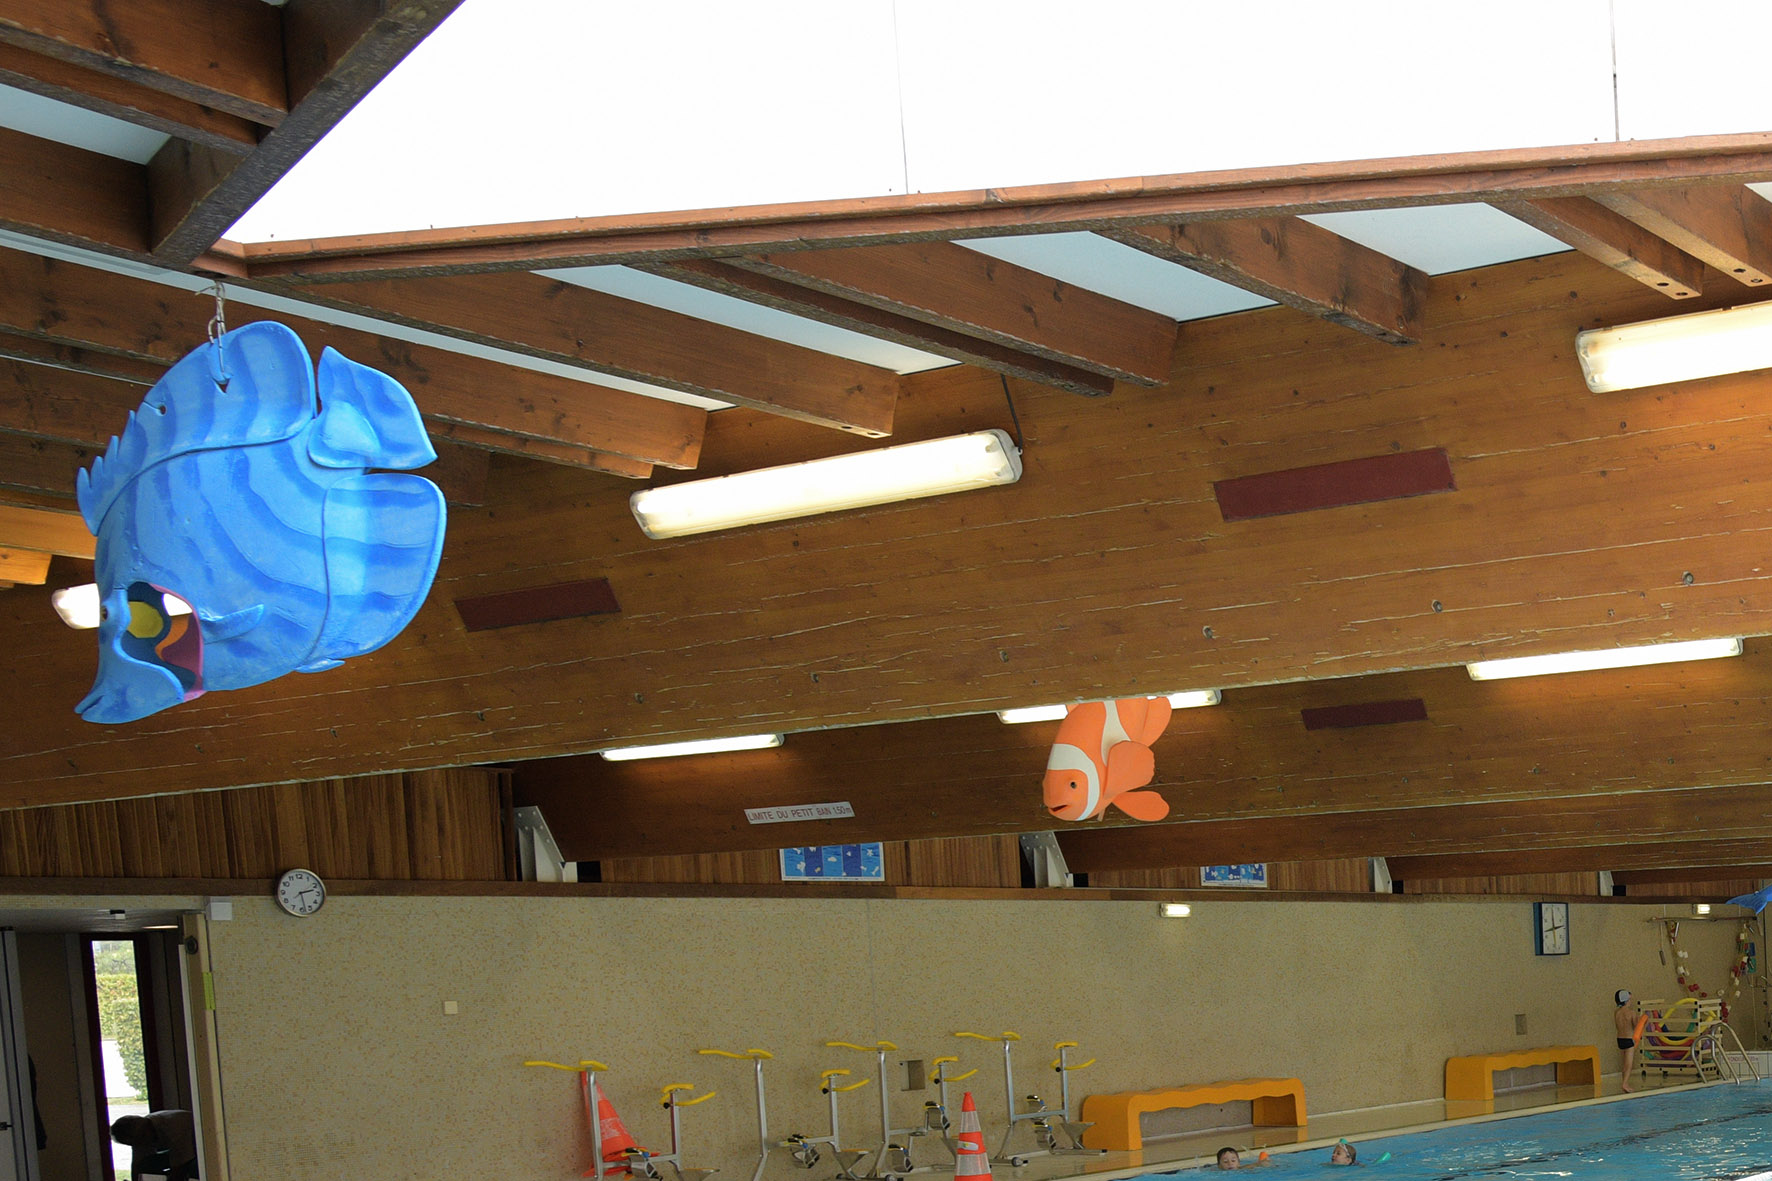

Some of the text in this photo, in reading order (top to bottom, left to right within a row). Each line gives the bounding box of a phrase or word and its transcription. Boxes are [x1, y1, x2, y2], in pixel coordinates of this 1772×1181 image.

[747, 811, 774, 821] LIMITE
[776, 809, 788, 819] DU
[791, 808, 814, 818] PETIT
[816, 807, 832, 816] BAIN
